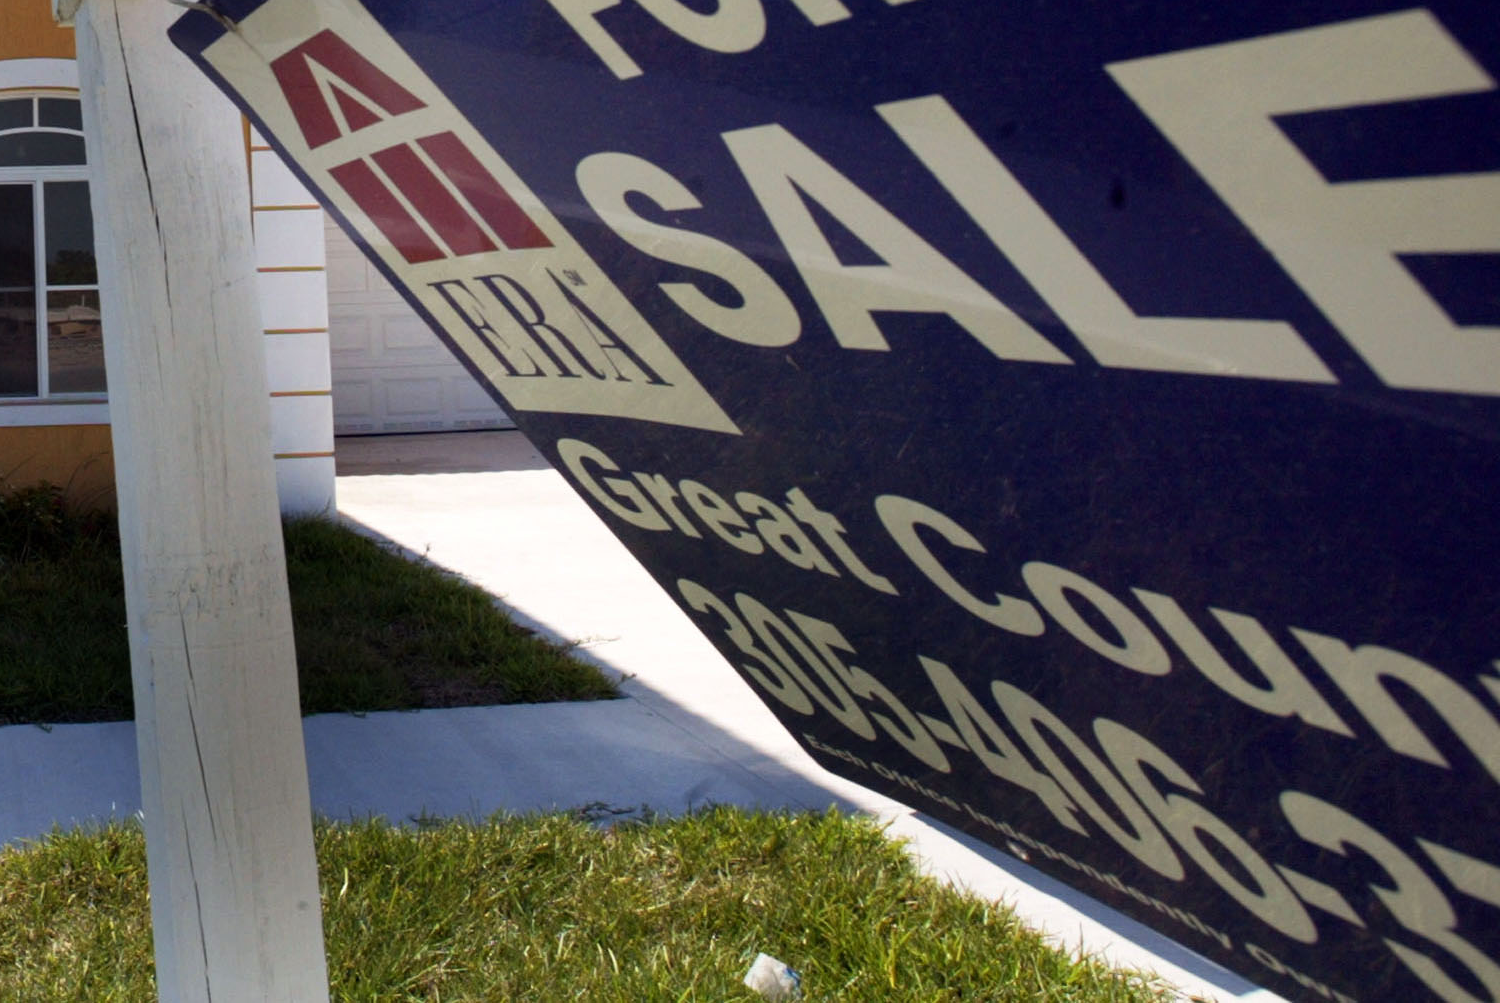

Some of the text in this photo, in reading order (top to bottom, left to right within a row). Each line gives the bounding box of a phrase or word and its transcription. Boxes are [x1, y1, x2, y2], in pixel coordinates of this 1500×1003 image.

[427, 267, 675, 387] ERA
[575, 7, 1500, 398] SALE
[557, 438, 1500, 784] Great Coun
[677, 578, 1500, 1003] 305-406-3
[802, 733, 868, 769] Each
[871, 762, 961, 811] Office
[962, 803, 1232, 949] Independently
